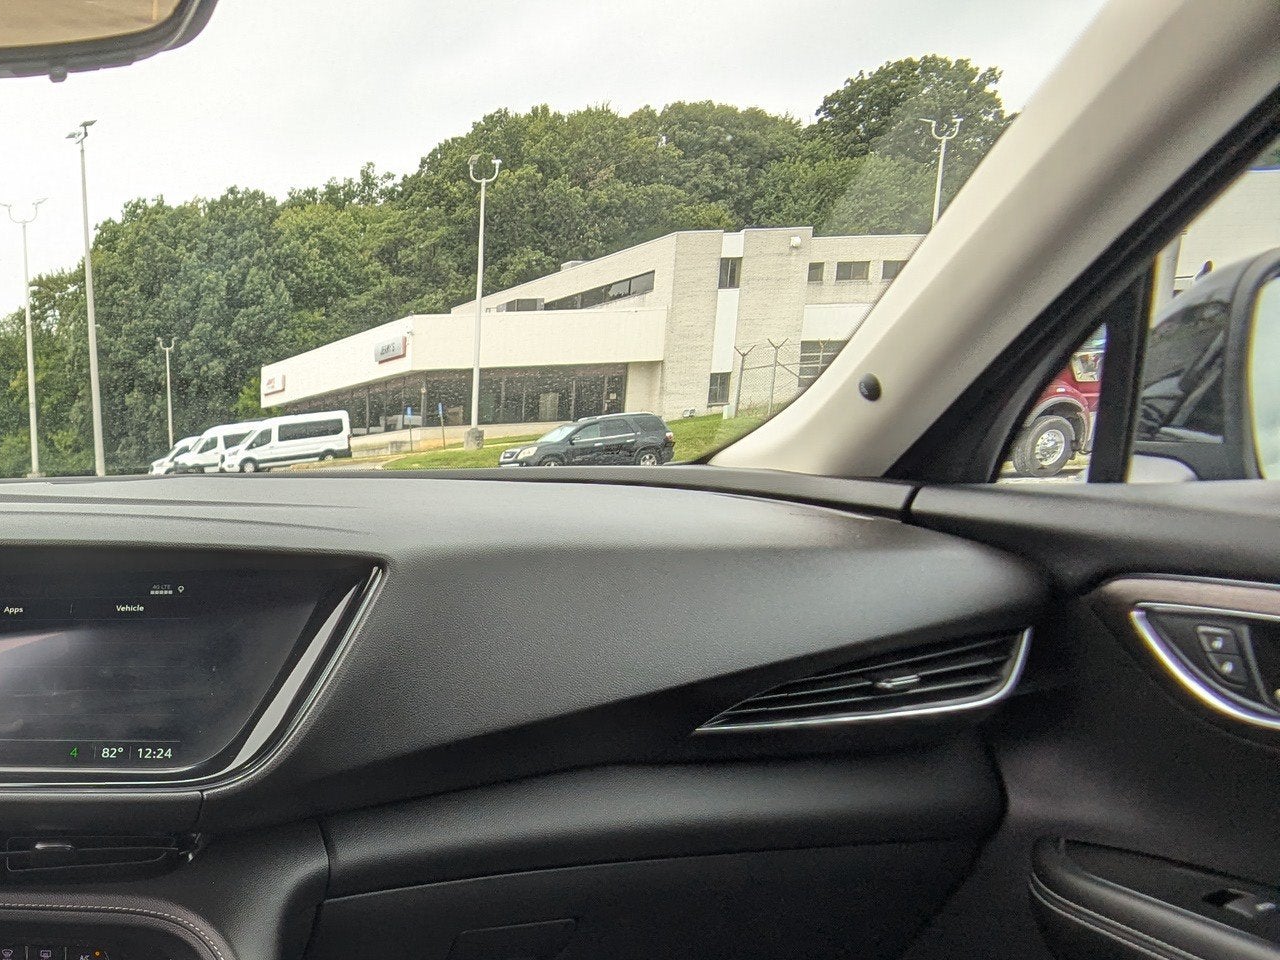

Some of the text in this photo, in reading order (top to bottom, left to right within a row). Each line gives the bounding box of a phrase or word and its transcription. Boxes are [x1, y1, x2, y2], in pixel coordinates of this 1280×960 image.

[3, 605, 24, 615] Apps
[116, 604, 145, 612] Vehicle
[137, 748, 173, 759] 12:24
